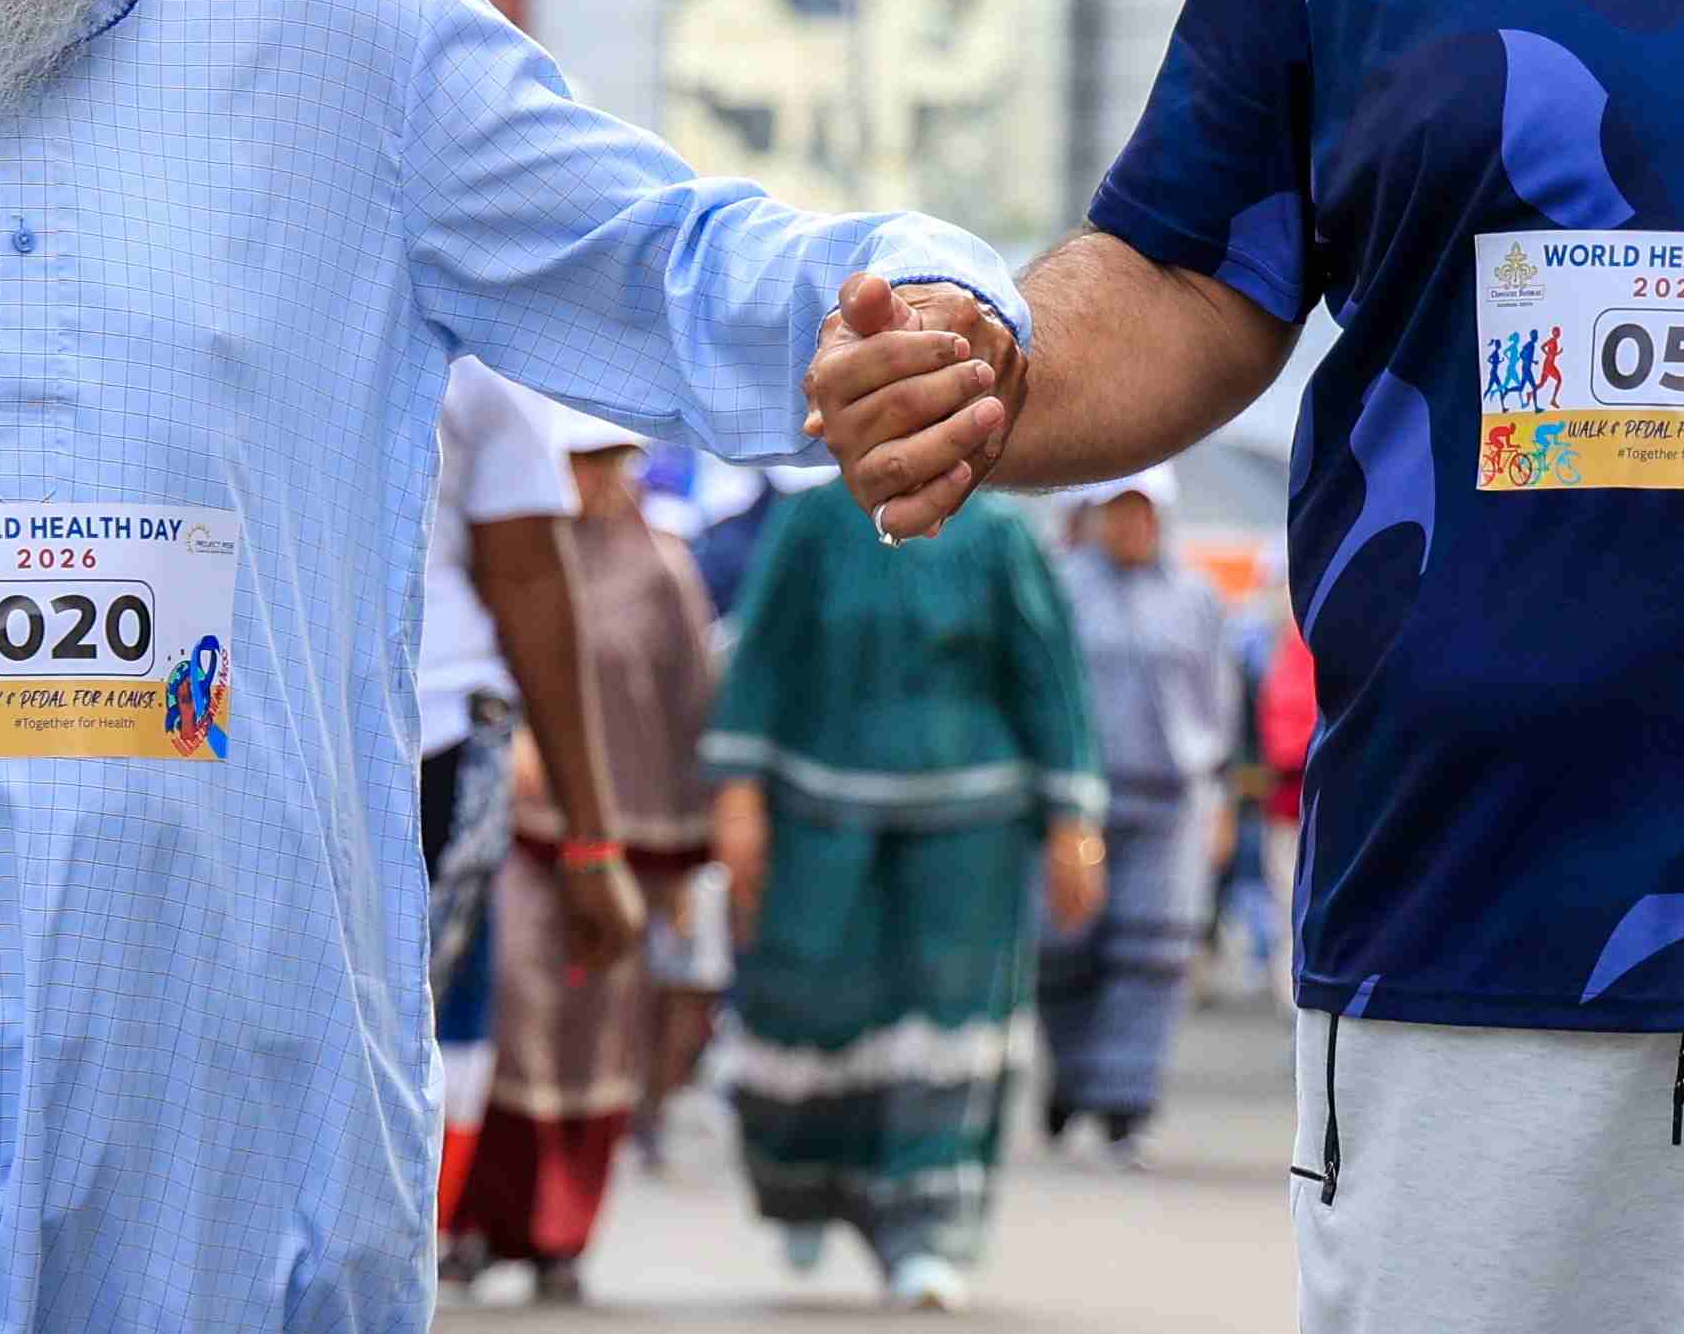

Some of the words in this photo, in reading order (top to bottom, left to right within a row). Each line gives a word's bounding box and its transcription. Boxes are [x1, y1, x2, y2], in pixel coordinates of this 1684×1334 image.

[1543, 244, 1640, 268] WORLD
[1567, 419, 1608, 438] WALK
[1624, 419, 1674, 439] PEDAL
[1617, 447, 1678, 463] #Together
[30, 516, 131, 540] HEALTH
[139, 518, 182, 541] DAY
[16, 548, 97, 569] 2026
[19, 689, 68, 709] PEDAL
[72, 689, 101, 708] FOR
[104, 690, 115, 709] A
[14, 717, 75, 731] #Together
[77, 716, 97, 729] for
[98, 717, 136, 729] Health
